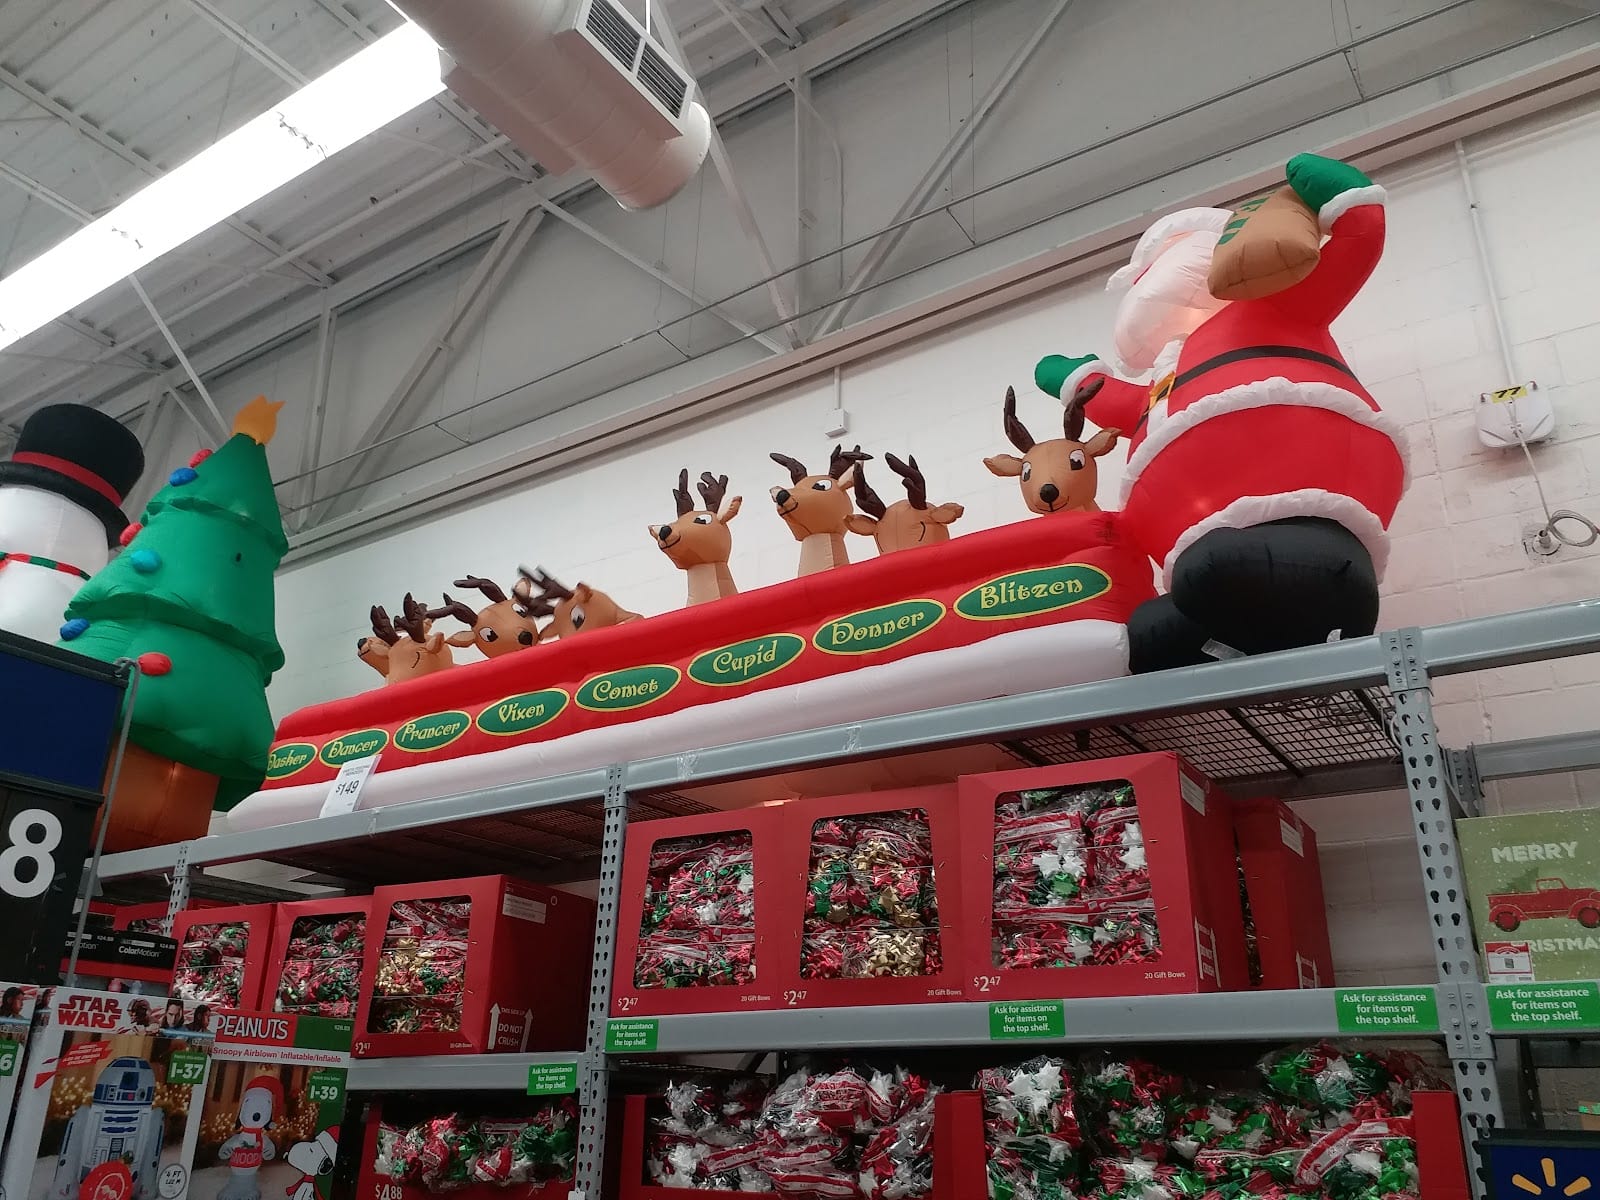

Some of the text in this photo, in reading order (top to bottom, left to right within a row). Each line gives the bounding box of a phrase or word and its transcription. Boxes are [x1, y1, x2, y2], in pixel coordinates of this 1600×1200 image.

[1494, 386, 1521, 398] 77
[979, 576, 1083, 610] Blitzen
[831, 611, 925, 646] Donner
[712, 640, 777, 676] Cupid
[592, 678, 659, 703] Comet
[498, 702, 545, 724] Vixen
[402, 719, 461, 743] Prancer
[328, 738, 379, 759] Dancer
[268, 750, 307, 770] Dasher
[336, 780, 359, 796] $149
[0, 809, 63, 898] 8
[1491, 841, 1578, 863] MERRY
[118, 946, 160, 957] ColorMotion
[1529, 936, 1600, 953] RISTMA
[1343, 993, 1427, 1003] Ask for assistance
[1496, 988, 1590, 999] Ask for assistance
[59, 995, 122, 1014] STAR
[994, 1006, 1007, 1014] Ask
[1008, 1005, 1019, 1013] for
[1356, 1004, 1371, 1013] for
[1373, 1004, 1400, 1013] items
[1511, 1001, 1527, 1010] for
[1529, 1000, 1560, 1009] items
[58, 1009, 120, 1029] WARS
[1004, 1015, 1015, 1023] for
[1355, 1014, 1419, 1025] the top shelf.
[1511, 1010, 1582, 1022] the top shelf.
[216, 1014, 288, 1040] PEANUTS
[498, 1023, 523, 1034] DO NOT
[1017, 1025, 1029, 1033] top
[1030, 1023, 1050, 1031] shelf.
[498, 1036, 519, 1046] CRUSH
[213, 1048, 242, 1057] Snoopy
[244, 1049, 277, 1058] Airblown
[171, 1062, 204, 1079] I-37
[310, 1085, 338, 1100] I-39
